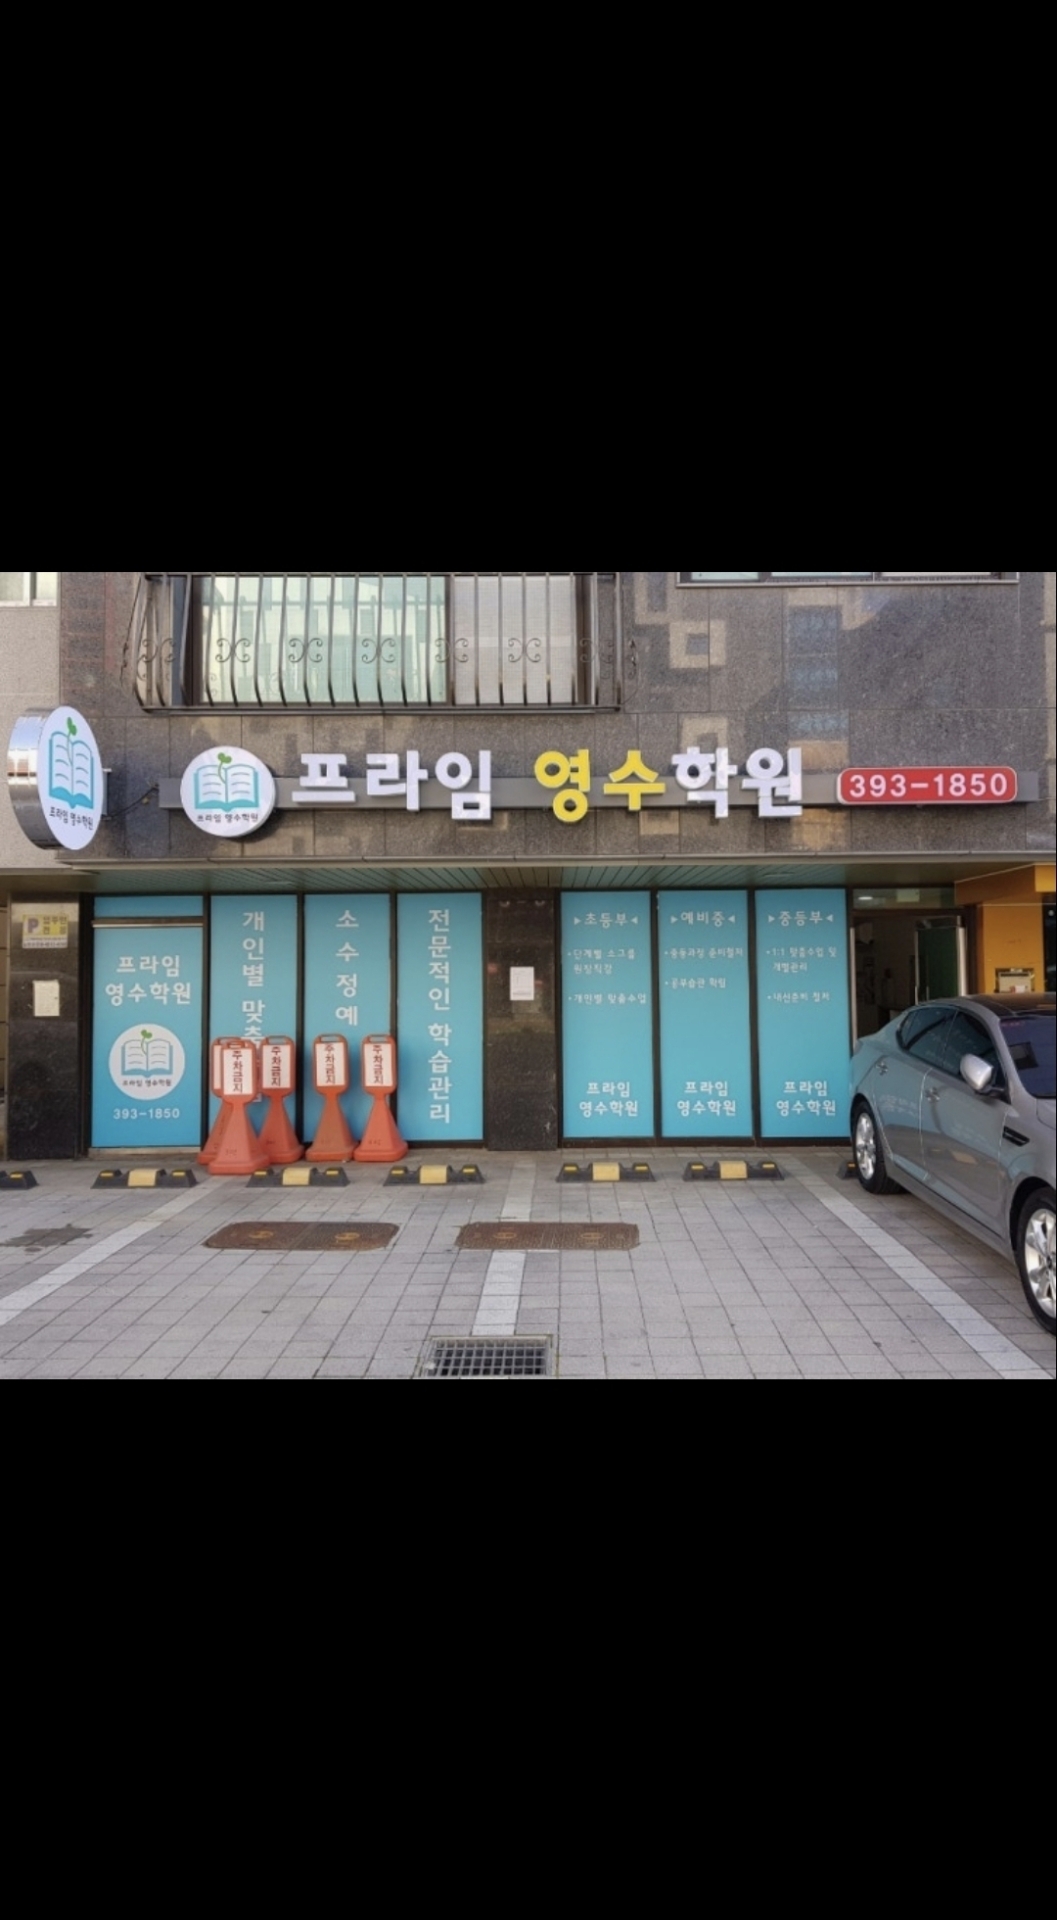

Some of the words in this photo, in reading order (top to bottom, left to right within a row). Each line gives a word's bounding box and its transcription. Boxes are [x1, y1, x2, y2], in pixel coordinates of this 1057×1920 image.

[292, 749, 494, 821] 프라임
[534, 746, 803, 823] 영수학원
[848, 771, 1009, 800] 393-1850
[49, 806, 68, 824] 프라임
[70, 812, 94, 831] 영수학원
[196, 813, 222, 824] 프라임
[224, 813, 259, 824] 영수학원
[27, 917, 39, 933] P
[584, 912, 629, 929] 초등부
[680, 911, 725, 928] 예비중
[778, 911, 823, 927] 중등부
[241, 910, 266, 987] 개인별
[573, 949, 602, 960] 단계별
[607, 949, 636, 960] 소그룹
[772, 947, 786, 956] 1:1
[789, 947, 825, 958] 맞춤수업
[828, 947, 837, 958] 및
[115, 955, 181, 977] 프라임
[335, 910, 360, 1026] 소수정예
[428, 909, 452, 1012] 전문적인
[773, 961, 808, 973] 개별관리
[671, 977, 706, 989] 공부습관
[105, 982, 192, 1007] 영수학원
[574, 993, 603, 1005] 개인별
[607, 993, 647, 1005] 맞춤수업
[232, 1051, 243, 1093] 주차금지
[270, 1046, 282, 1087] 주차금지
[324, 1044, 336, 1084] 주차금지
[372, 1044, 384, 1085] 주차금지
[428, 1022, 453, 1124] 학습관리
[123, 1079, 143, 1087] 프라임
[145, 1079, 172, 1087] 영수학원
[586, 1081, 631, 1098] 프라임
[684, 1080, 729, 1097] 프라임
[783, 1080, 828, 1097] 프라임
[113, 1107, 181, 1120] 393-1850
[579, 1100, 639, 1118] 영수학원
[677, 1099, 737, 1117] 영수학원
[775, 1098, 837, 1117] 영수학원
